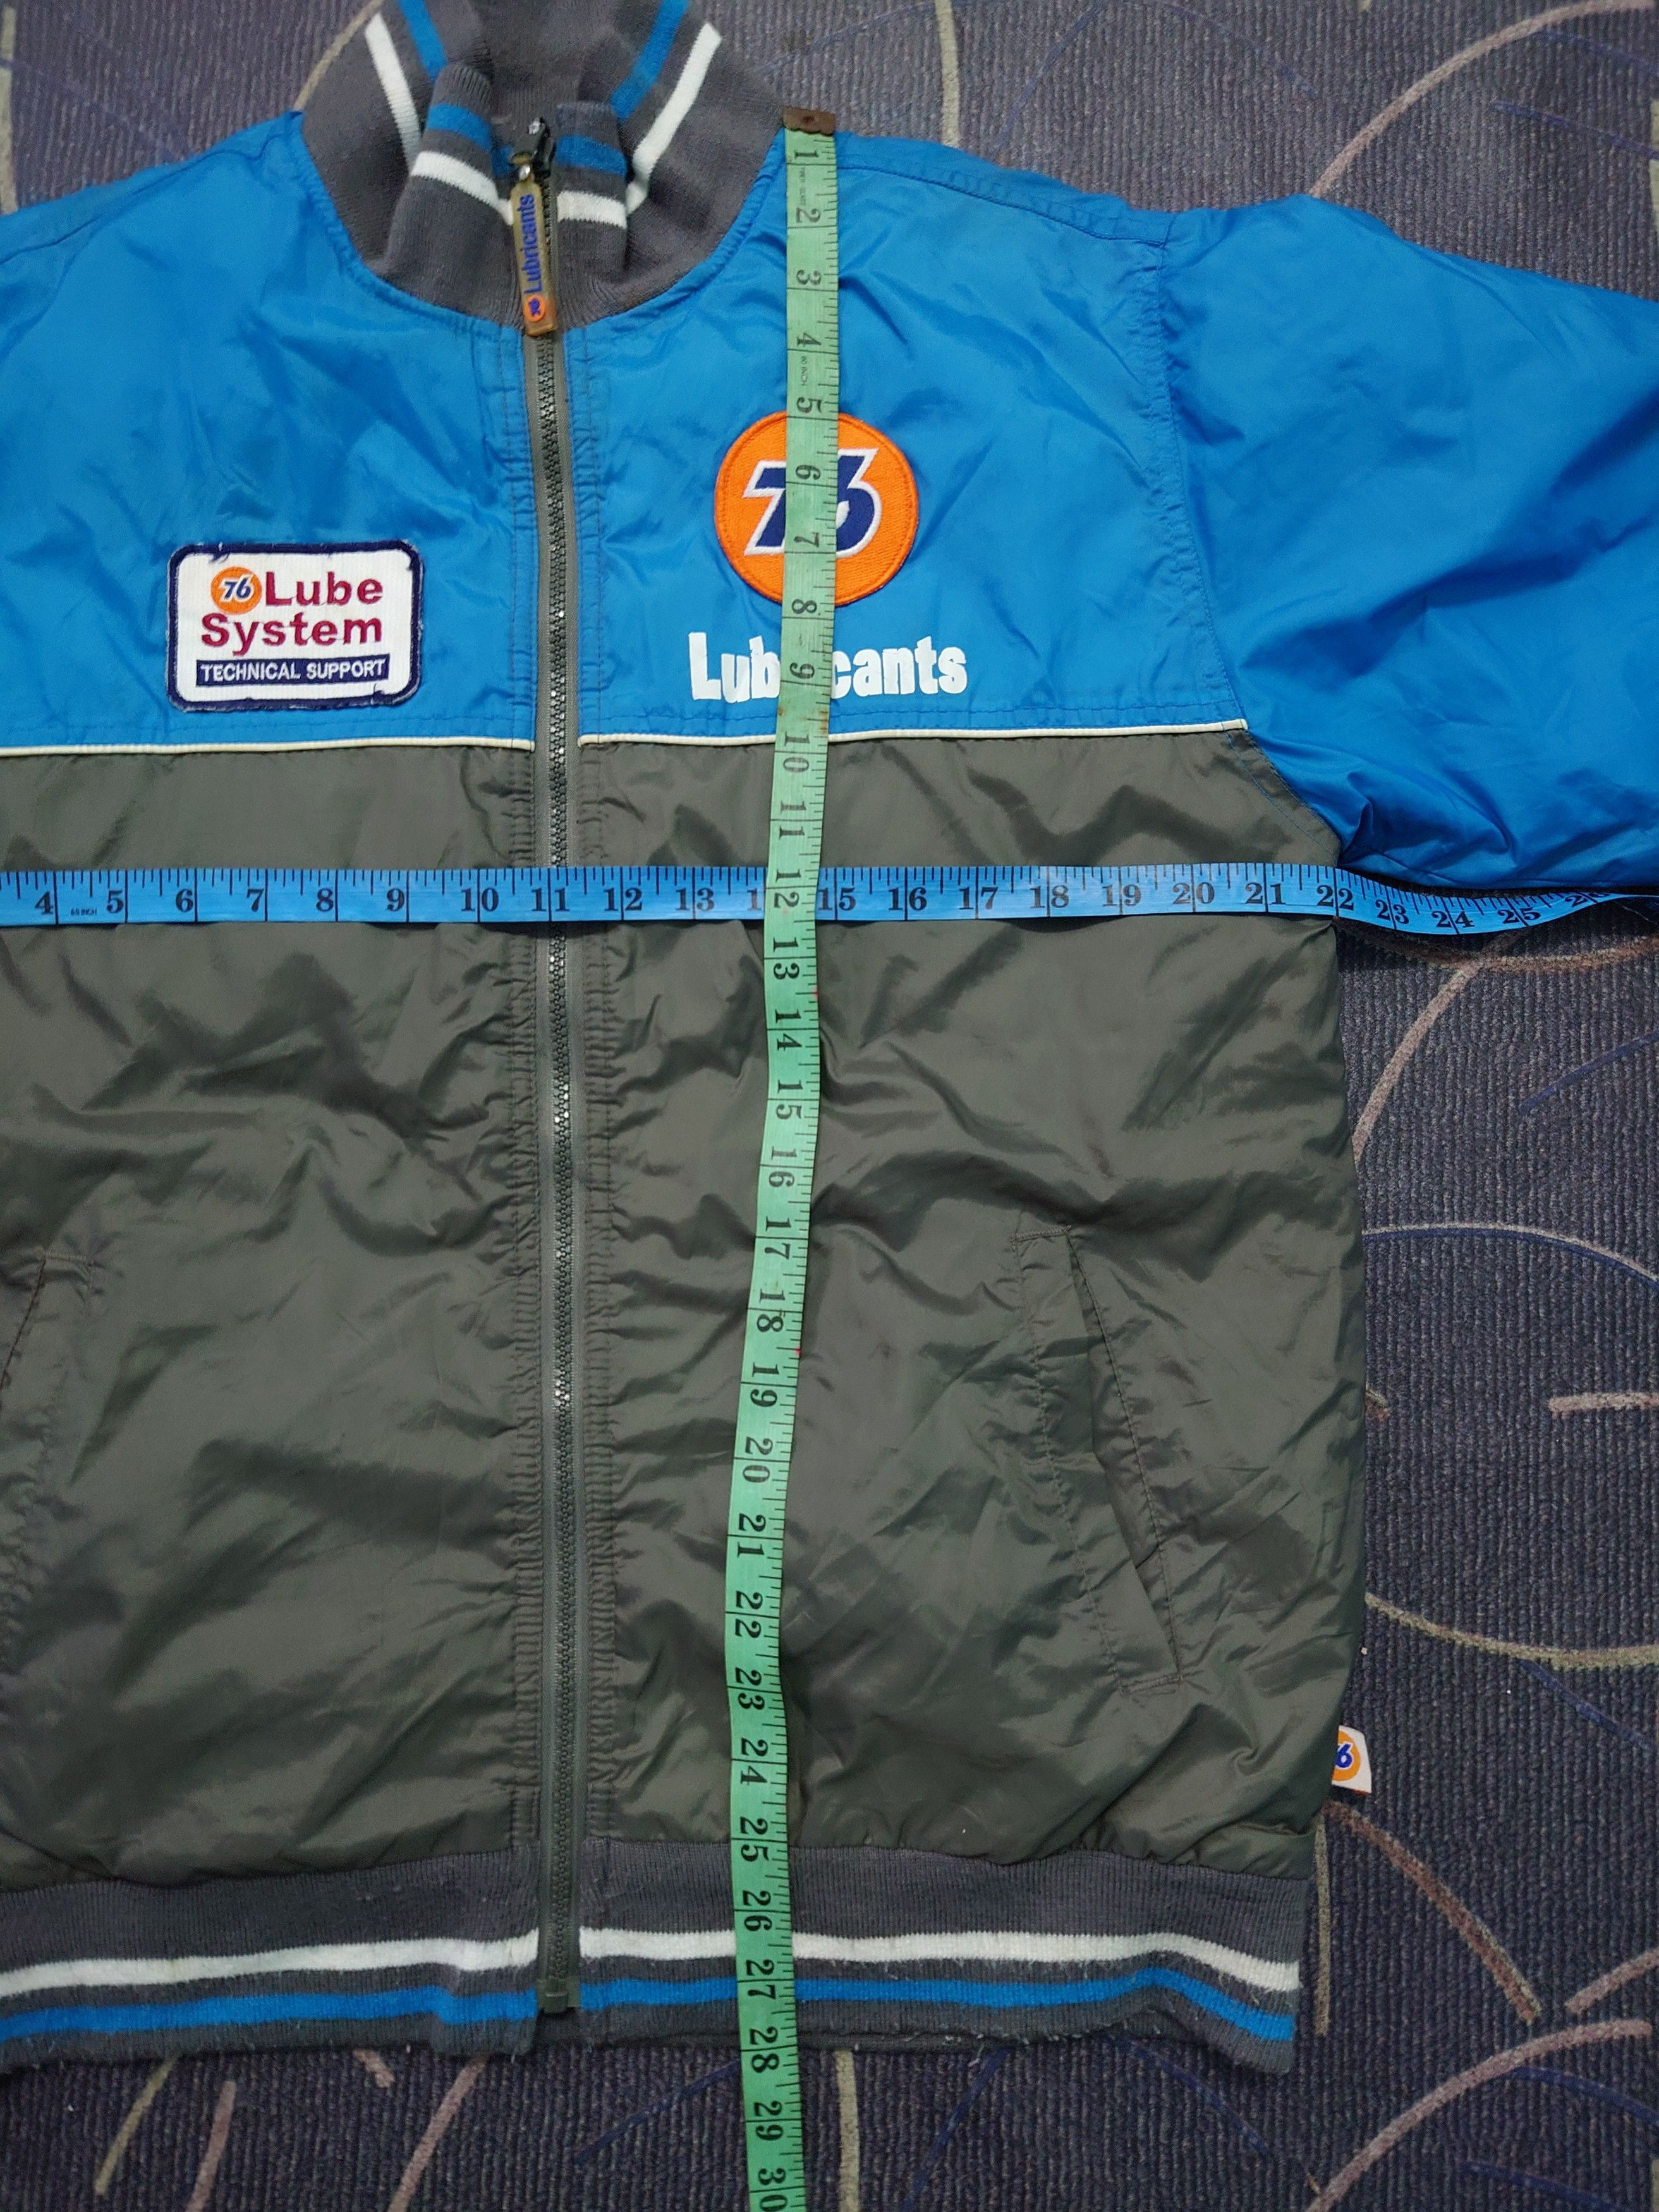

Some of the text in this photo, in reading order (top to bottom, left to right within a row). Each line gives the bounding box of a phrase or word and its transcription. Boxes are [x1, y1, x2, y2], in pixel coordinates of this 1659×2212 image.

[794, 150, 818, 159] 1
[796, 207, 820, 223] 2
[517, 193, 542, 294] Lubricants
[796, 270, 822, 286] 3
[797, 332, 822, 346] 4
[796, 397, 822, 413] 5
[795, 465, 821, 480] 6
[794, 532, 819, 547] 7
[220, 571, 383, 607] 76 Lube
[791, 599, 818, 614] 8
[202, 611, 382, 656] System
[200, 658, 386, 682] TECHNICAL SUPPORT
[689, 632, 967, 703] Lubcants
[789, 662, 815, 679] 9
[783, 731, 811, 773] 10
[779, 801, 806, 840] 11
[176, 889, 193, 912] 6
[247, 889, 264, 911] 7
[316, 889, 334, 911] 8
[386, 889, 405, 911] 9
[460, 887, 499, 913] 10
[532, 887, 570, 911] 11
[604, 887, 642, 911] 12
[676, 887, 715, 911] 13
[774, 869, 801, 908] 12
[818, 887, 856, 911] 15
[889, 887, 927, 911] 16
[959, 887, 997, 910] 17
[1030, 886, 1069, 909] 18
[1102, 885, 1141, 907] 19
[1173, 884, 1215, 905] 20
[1245, 882, 1284, 905] 21
[1316, 885, 1355, 910] 22
[35, 891, 54, 915] 4
[107, 889, 123, 913] 5
[1375, 899, 1409, 925] 23
[1431, 911, 1474, 928] 24
[1497, 908, 1540, 924] 25
[773, 937, 800, 980] 13
[775, 1009, 802, 1051] 14
[776, 1079, 803, 1121] 15
[769, 1146, 797, 1188] 16
[764, 1217, 791, 1260] 17
[757, 1288, 786, 1333] 18
[750, 1362, 780, 1407] 19
[743, 1437, 773, 1483] 20
[737, 1513, 766, 1558] 21
[734, 1591, 763, 1639] 22
[735, 1667, 765, 1711] 23
[740, 1738, 769, 1785] 24
[740, 1816, 770, 1863] 25
[743, 1890, 772, 1931] 26
[746, 1959, 776, 2000] 27
[749, 2026, 779, 2074] 28
[753, 2101, 783, 2141] 29
[758, 2168, 787, 2212] 30
